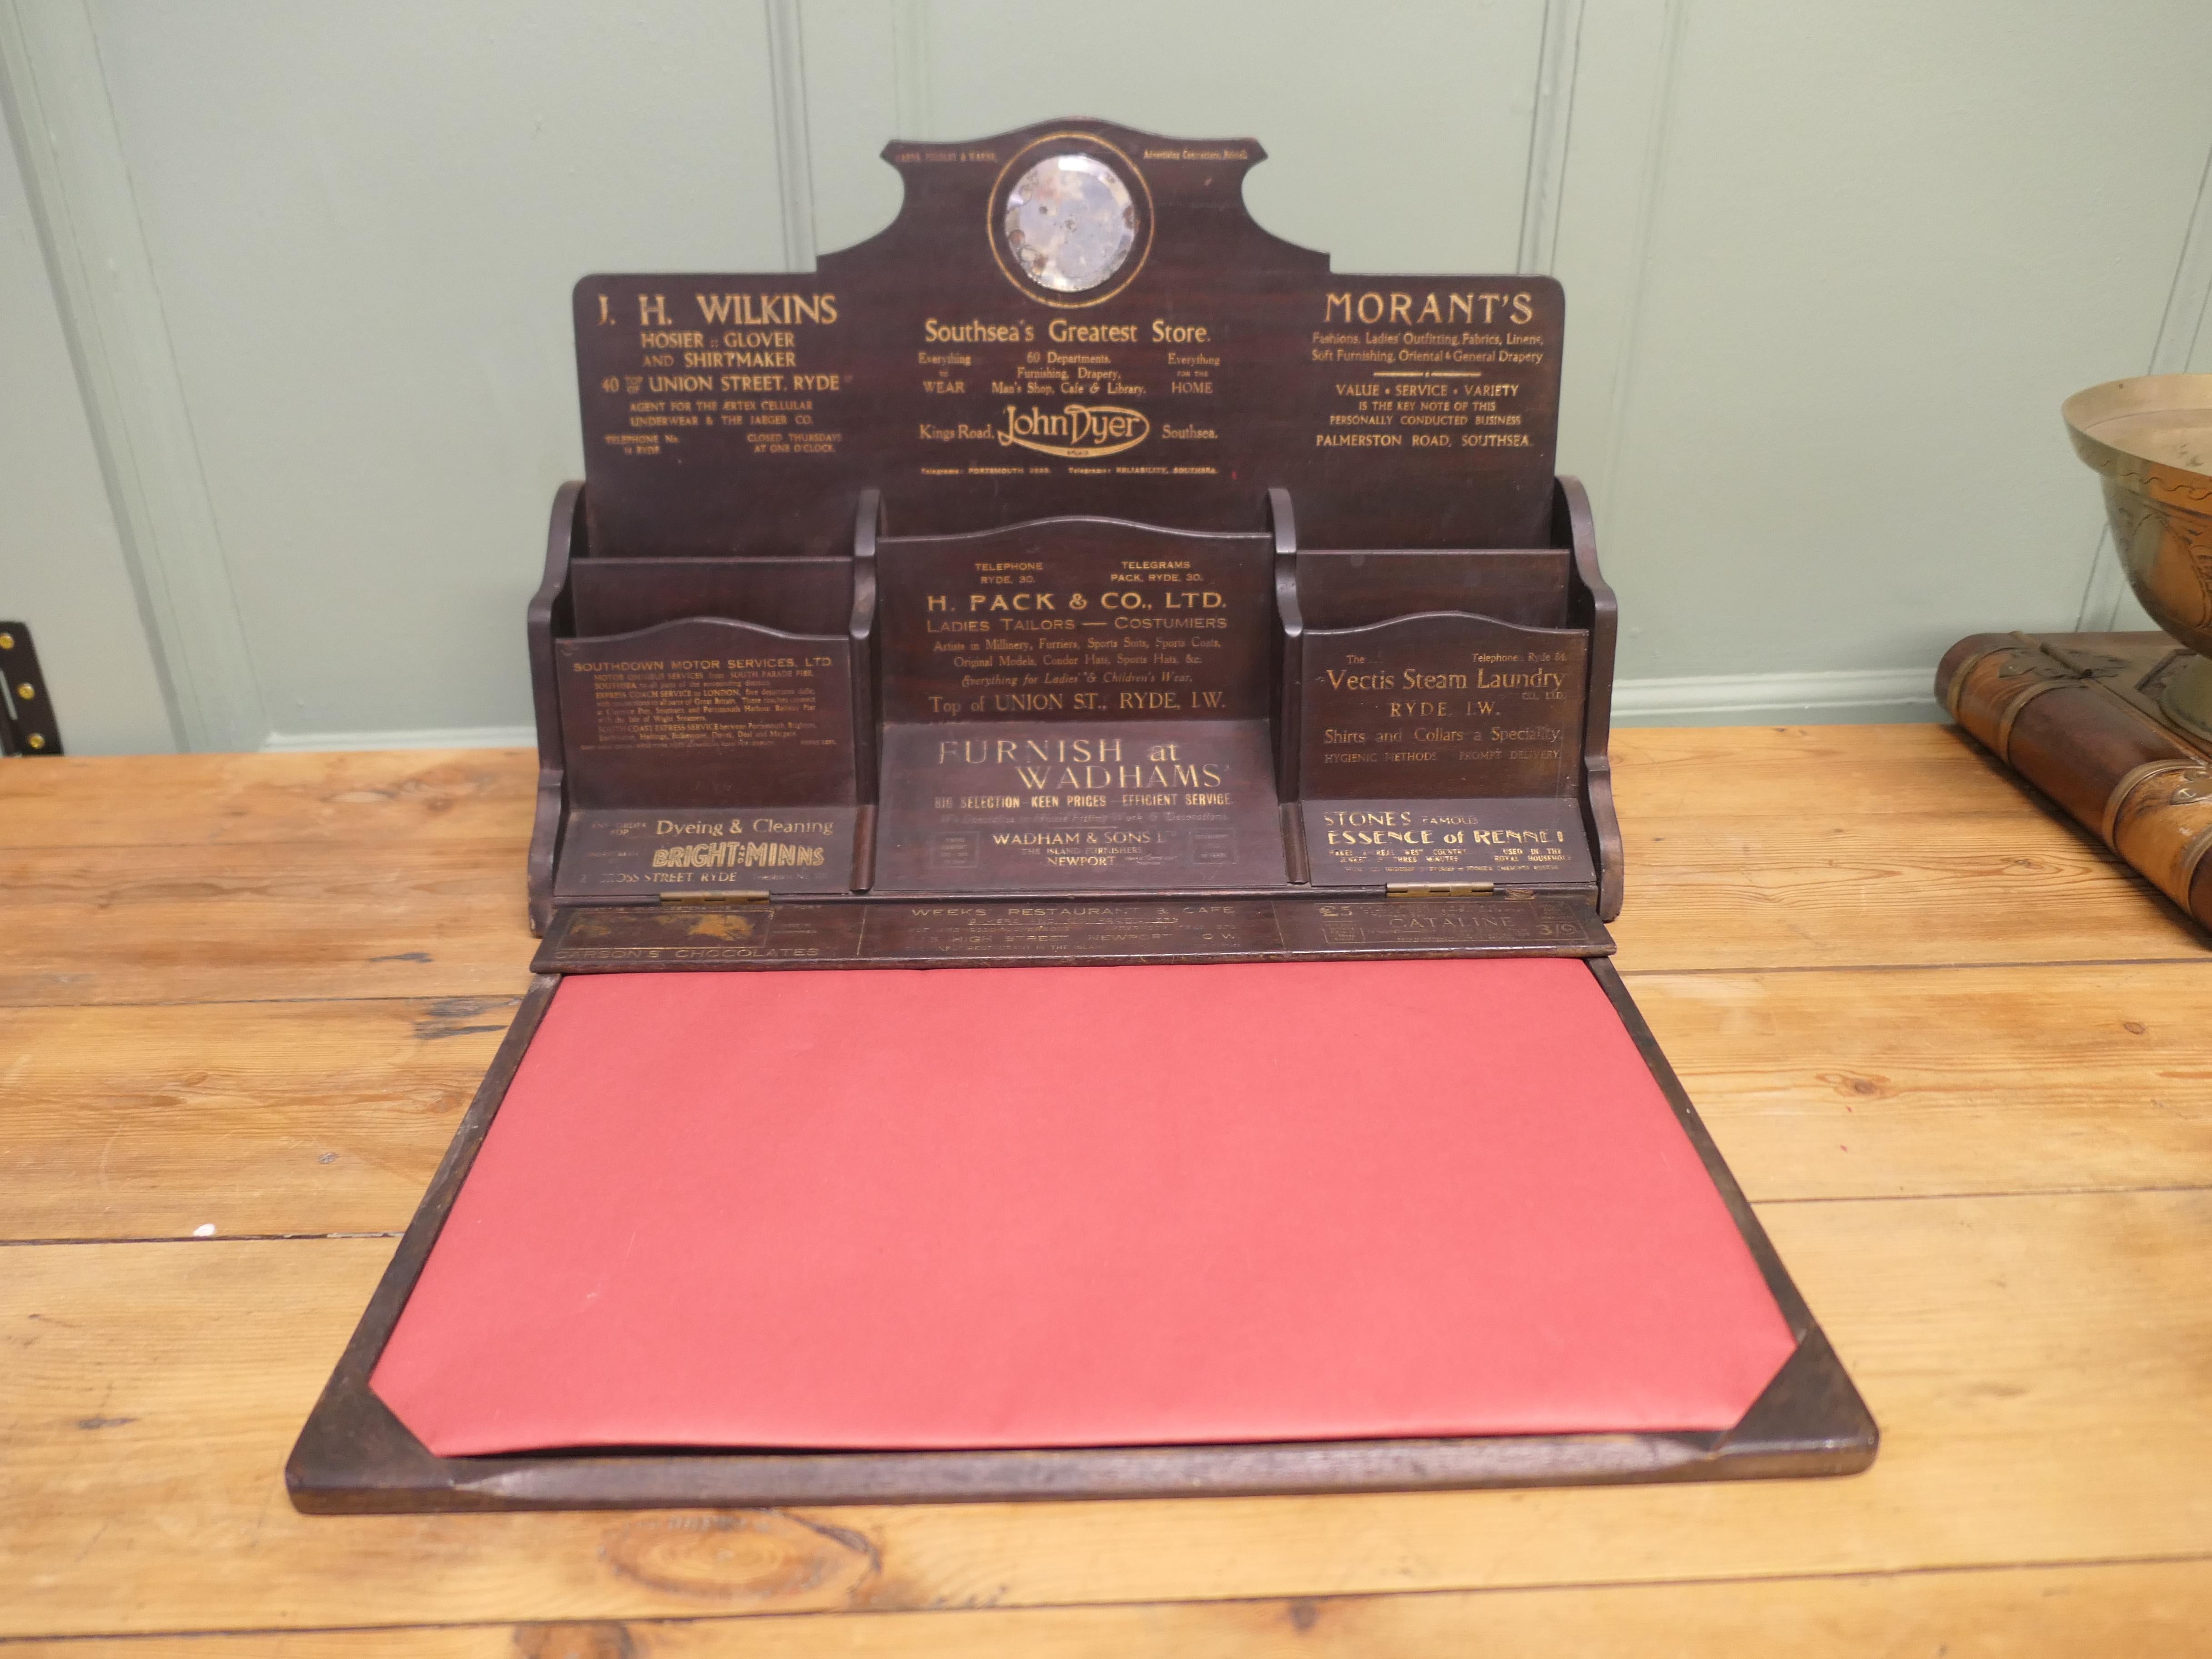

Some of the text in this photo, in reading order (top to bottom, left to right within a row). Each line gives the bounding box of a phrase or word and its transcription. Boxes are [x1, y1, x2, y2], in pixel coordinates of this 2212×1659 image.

[598, 293, 838, 326] J. H. WILKINS
[1322, 292, 1533, 324] MORANT'S
[925, 318, 1210, 342] Southsea's Greatest Store.
[641, 332, 795, 348] HOSIER GLOVER
[1463, 333, 1502, 345] Fabrics,
[643, 352, 796, 367] AND SHIRTMAKER
[918, 352, 971, 366] Everything
[1027, 352, 1040, 363] 60
[1167, 352, 1220, 366] Everything
[1312, 350, 1332, 361] Soft
[1399, 350, 1443, 361] Oriental
[1454, 350, 1494, 362] General
[1499, 352, 1543, 363] Drapery
[603, 376, 619, 392] 40
[649, 376, 713, 392] UNION
[794, 375, 840, 390] RYDE
[924, 381, 965, 393] WEAR
[1090, 382, 1100, 393] &
[1171, 382, 1212, 393] HOME
[1336, 384, 1519, 396] VALUE SERVICE VARIETY
[630, 401, 813, 411] AGENT FOR THE CELLULAR
[1359, 402, 1496, 410] IS THE KEY NOTE OF THIS
[629, 416, 698, 426] UNDERWEAR
[721, 416, 743, 425] THE
[750, 416, 787, 424] JAEGER
[1330, 416, 1521, 425] PERSONALLY CONDUCTED BUSINESS
[920, 425, 955, 441] Kings
[1162, 425, 1217, 438] Southsea.
[1317, 435, 1402, 446] PALMERSTON
[1462, 435, 1533, 446] SOUTHSEA.
[975, 563, 1043, 571] TELEPHONE
[1122, 561, 1191, 569] TELEGRAMS
[927, 592, 1227, 612] H. PACK & CO., LTD.
[934, 641, 965, 651] Artists
[970, 641, 979, 650] in
[1087, 638, 1117, 649] Sports
[574, 661, 664, 672] SOUTHDOWN
[671, 659, 720, 669] MOTOR
[954, 657, 993, 669] Original
[1043, 656, 1078, 665] Condor
[1117, 655, 1147, 665] Sports
[961, 674, 1017, 687] Everything
[1023, 675, 1038, 686] for
[1327, 668, 1565, 691] Vectis Steam Laundry
[929, 696, 961, 716] Top
[971, 696, 985, 711] of
[995, 694, 1063, 710] UNION
[1120, 692, 1180, 710] RYDE,
[1324, 730, 1364, 744] Shirts
[1376, 730, 1401, 742] and
[1415, 729, 1463, 742] Collars
[1474, 733, 1482, 741] a
[939, 739, 1178, 764] FURNISH at
[1016, 764, 1229, 789] WADHAMS'
[961, 796, 1020, 808] SELECTION
[1031, 796, 1058, 807] KEEN
[1067, 795, 1106, 807] PRICES
[1122, 794, 1177, 806] EFFICIENT
[1324, 812, 1410, 826] STONES
[657, 820, 723, 836] Dyeing
[730, 819, 743, 833] &
[753, 819, 834, 835] Cleaning
[993, 832, 1150, 845] WADHAM & SONS
[1327, 830, 1433, 845] ESSENCE
[1444, 831, 1463, 844] of
[652, 842, 739, 867] BRIGHT
[745, 842, 824, 866] MINNS
[1046, 857, 1116, 866] NEWPORT
[645, 872, 737, 882] STREET RYDE
[1389, 917, 1514, 928] CATALINE
[675, 948, 819, 958] CHOCOLATES
